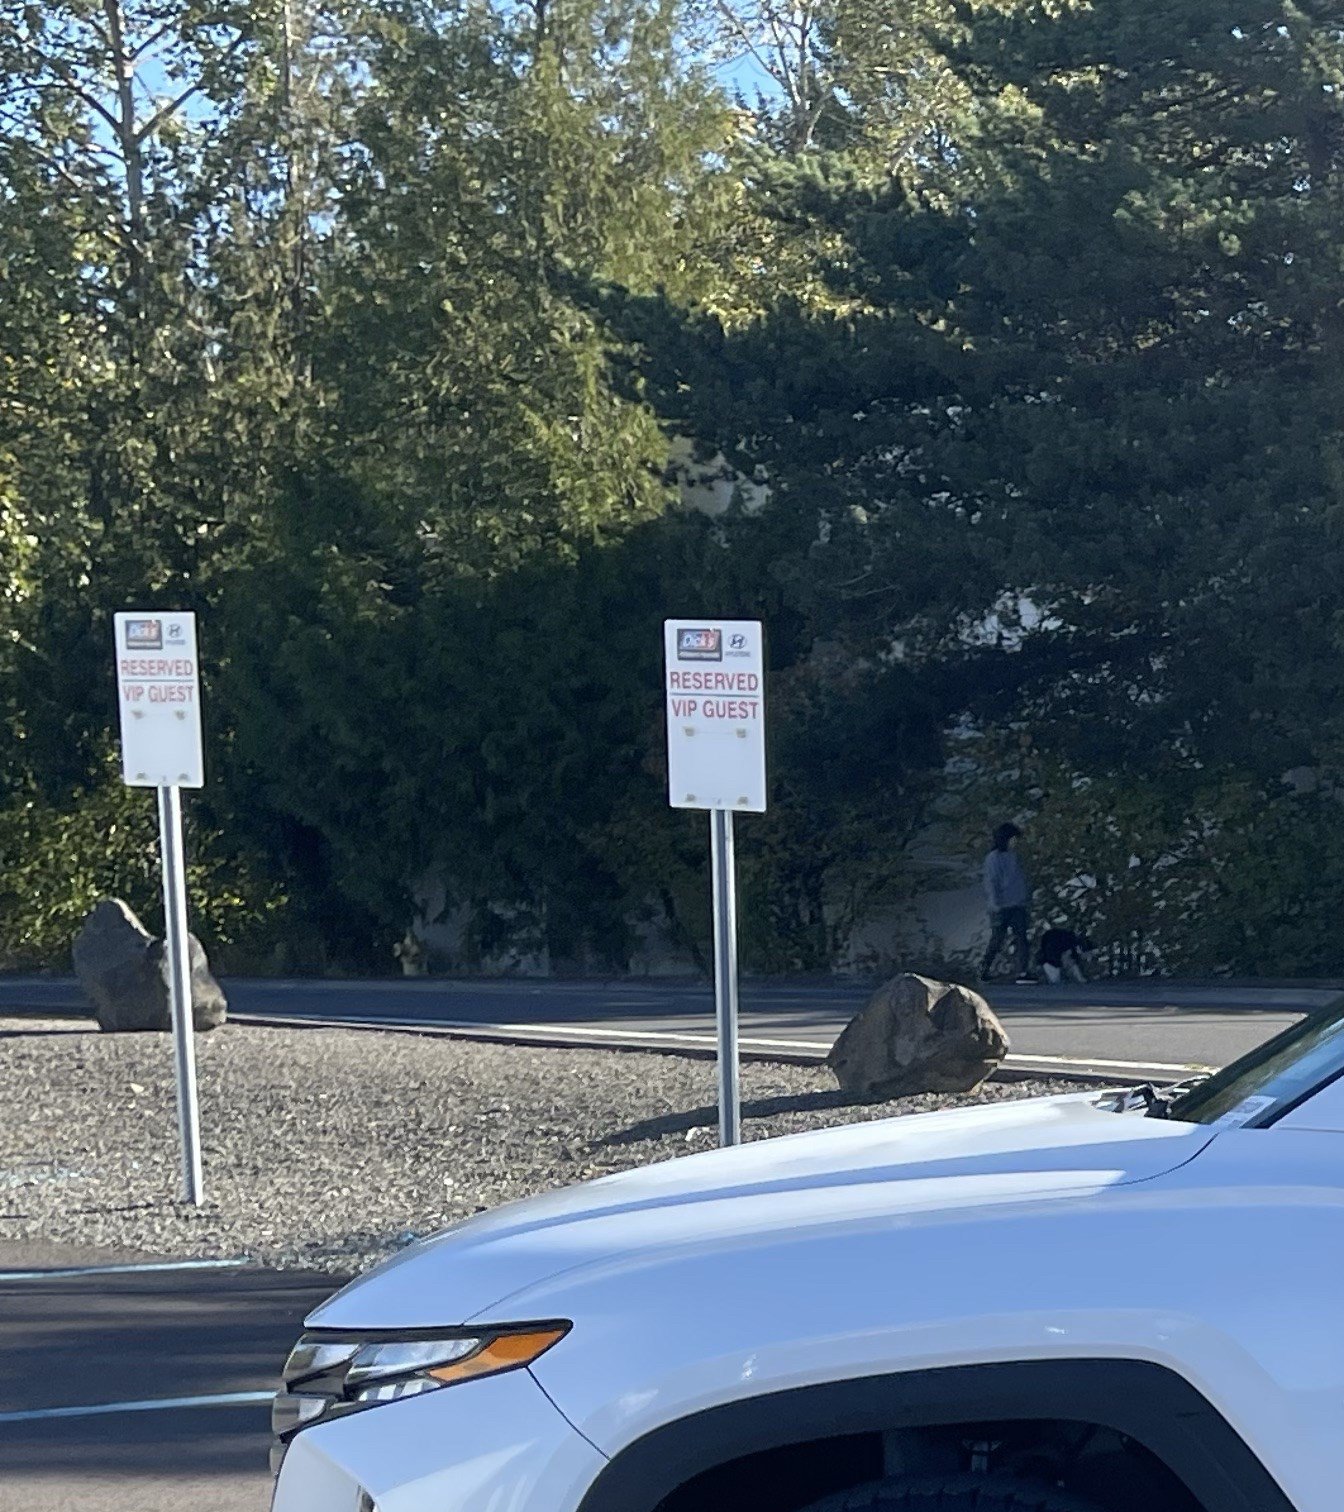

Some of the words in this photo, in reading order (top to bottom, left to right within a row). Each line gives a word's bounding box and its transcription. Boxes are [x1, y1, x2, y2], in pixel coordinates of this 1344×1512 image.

[120, 659, 194, 676] RESERVED
[669, 671, 758, 691] RESERVED
[122, 685, 144, 701] VIP
[148, 685, 194, 702] GUEST
[671, 699, 697, 717] VIP
[702, 700, 759, 720] GUEST
